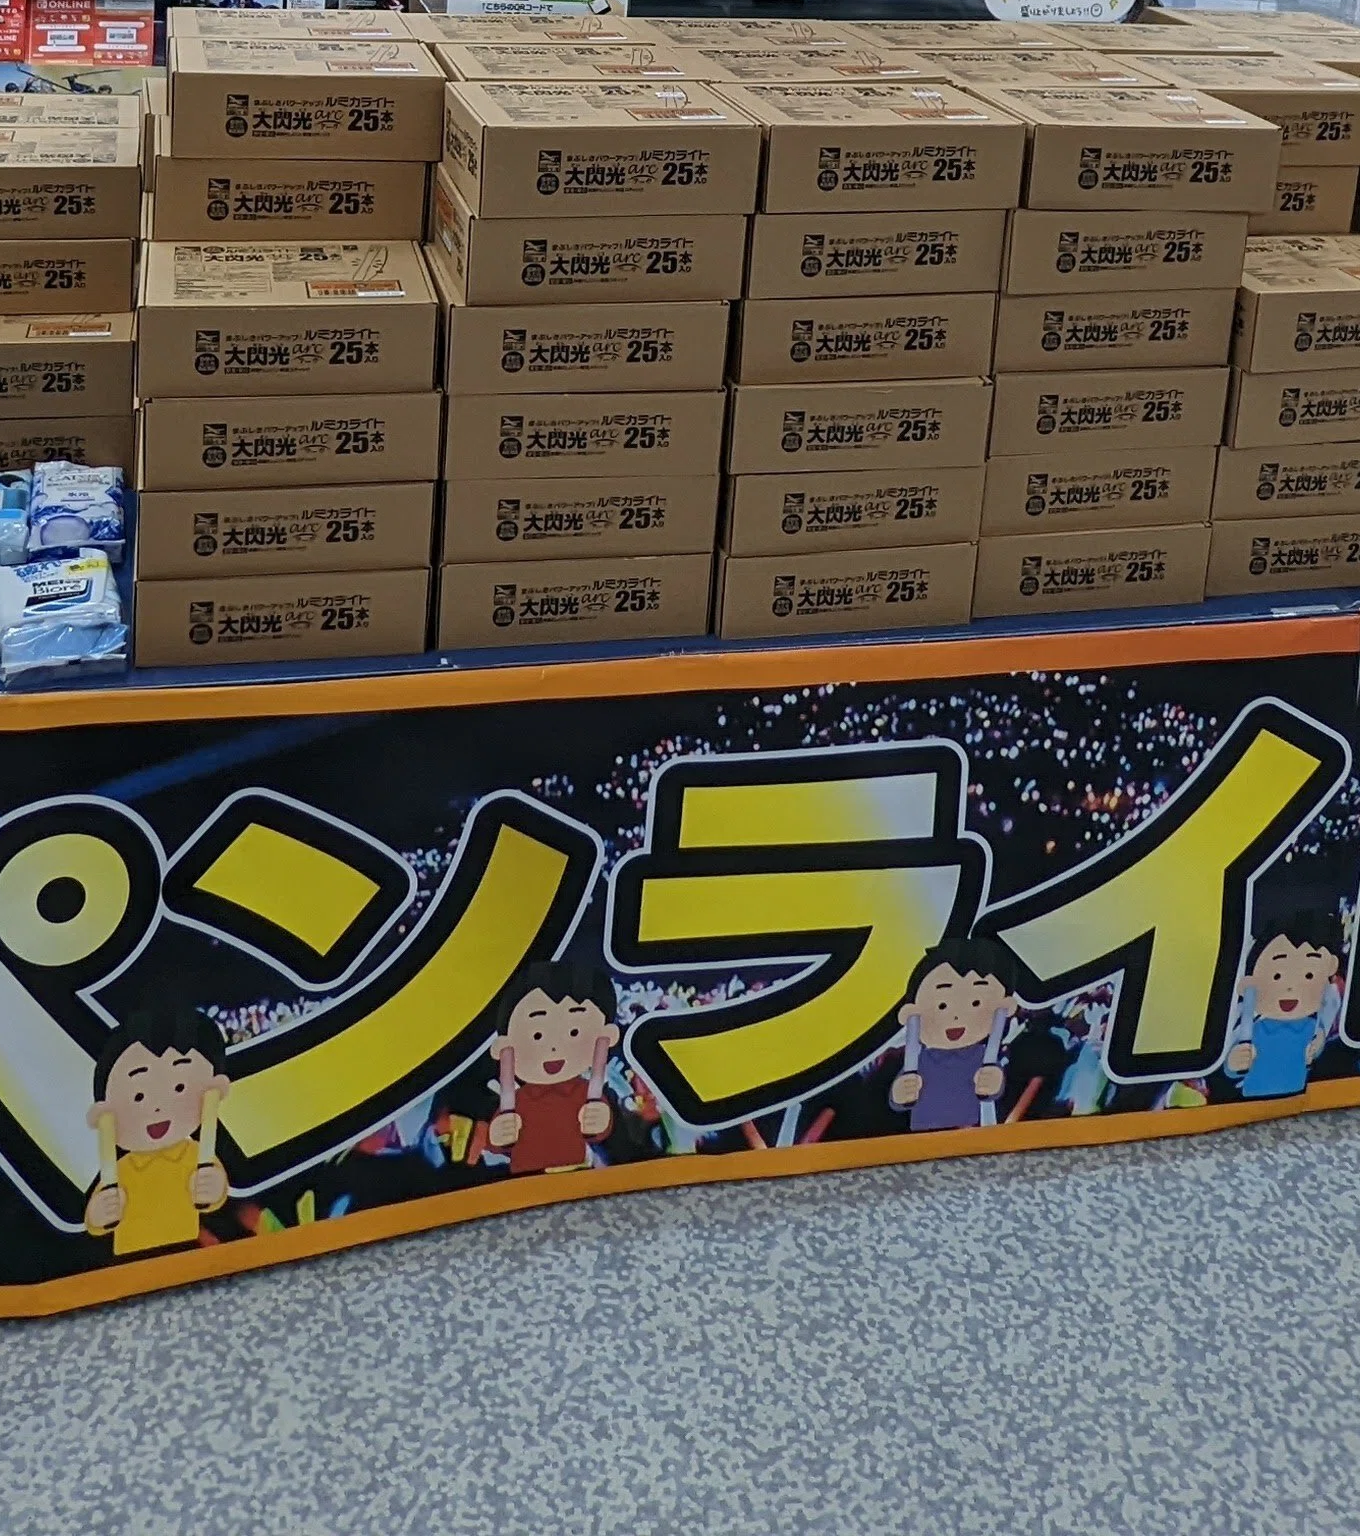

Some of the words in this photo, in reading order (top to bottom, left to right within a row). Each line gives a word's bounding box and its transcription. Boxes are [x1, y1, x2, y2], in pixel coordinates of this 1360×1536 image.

[49, 0, 90, 10] ONLINE
[325, 96, 395, 108] ルミカライト
[253, 109, 312, 130] 大閃光
[639, 150, 710, 162] ルミカライト
[911, 145, 976, 161] ルミカライト
[564, 166, 625, 186] 大閃光
[842, 159, 899, 183] 大閃光
[797, 582, 853, 607] 大閃光
